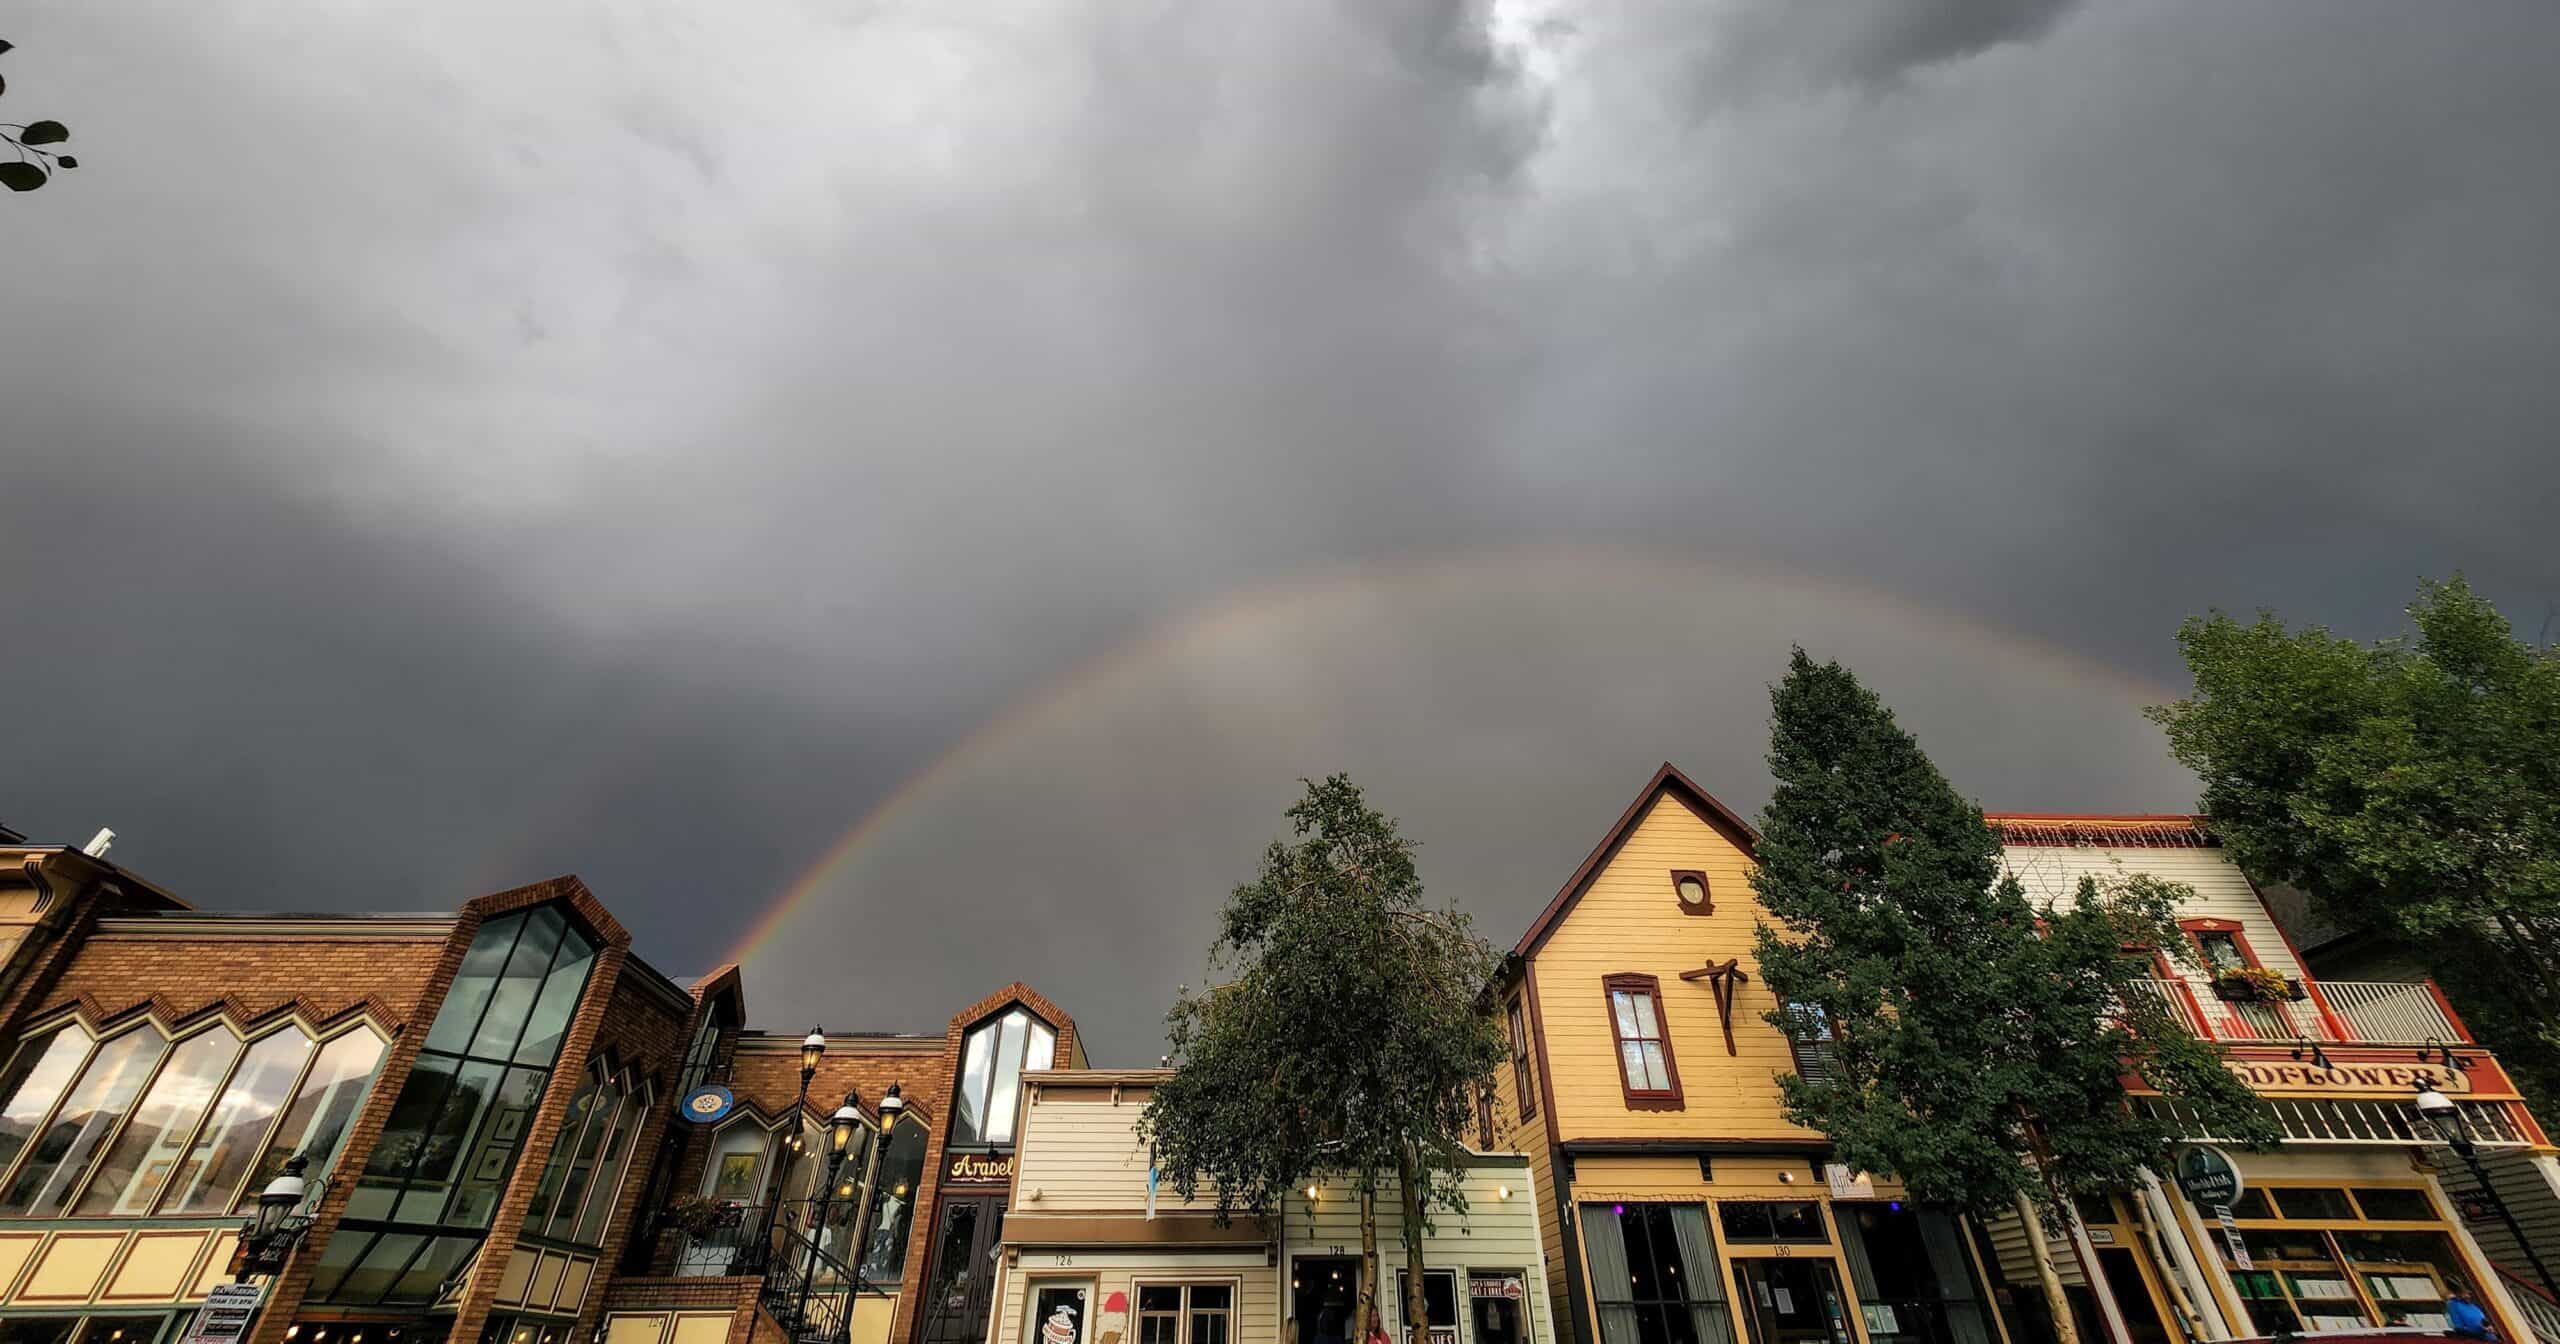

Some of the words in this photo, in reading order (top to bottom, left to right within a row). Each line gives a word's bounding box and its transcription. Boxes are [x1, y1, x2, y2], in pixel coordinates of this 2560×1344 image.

[2239, 1066, 2443, 1087] DFLOWER
[1329, 1245, 1345, 1256] 128
[1774, 1246, 1791, 1256] 130
[1056, 1255, 1072, 1266] 126
